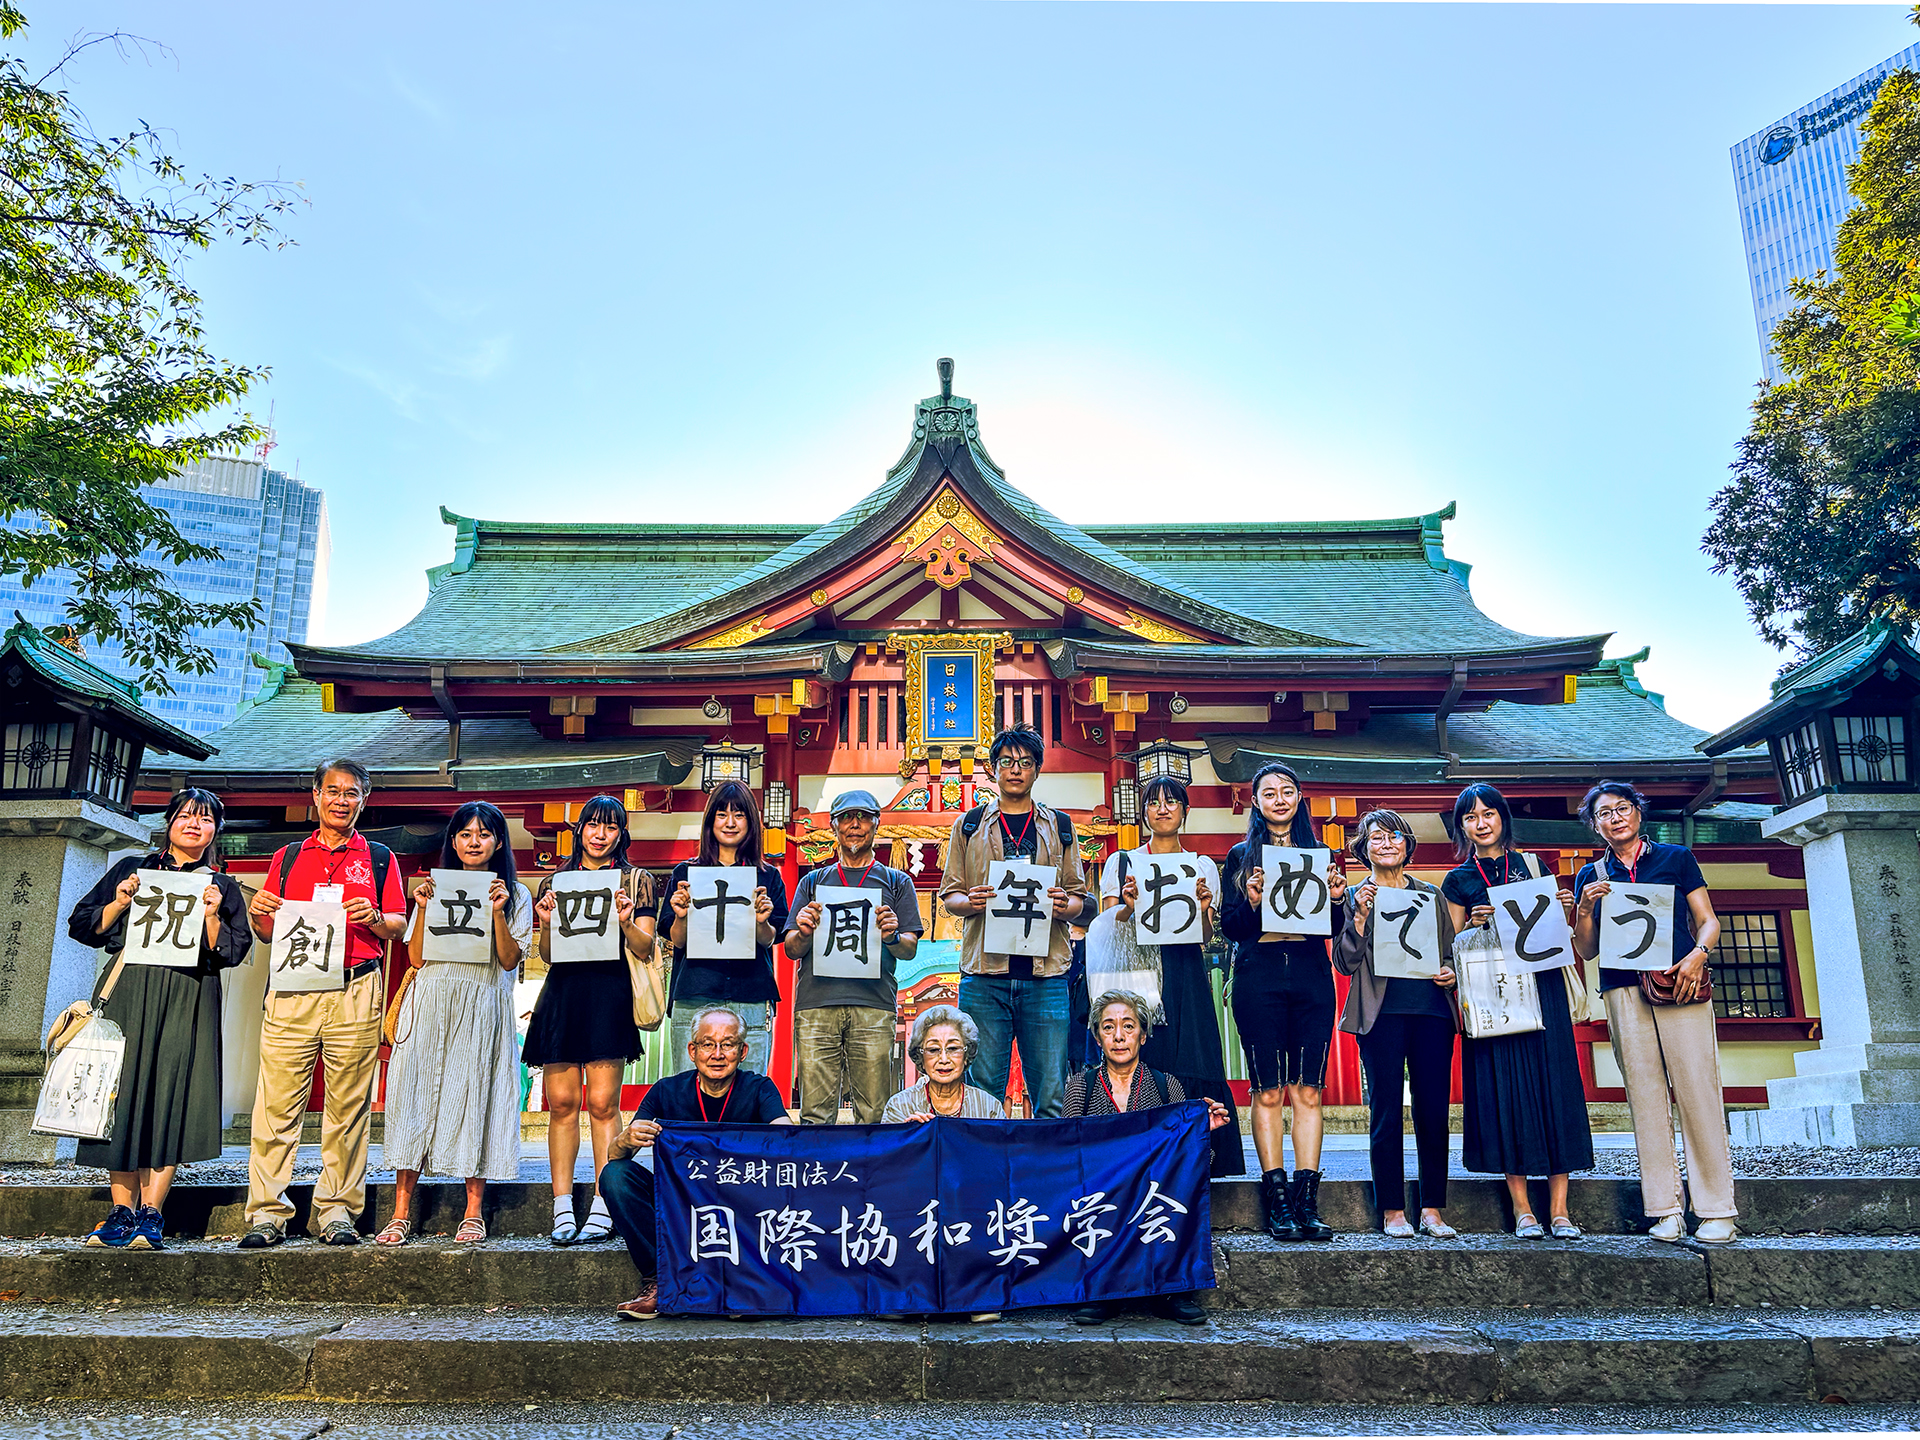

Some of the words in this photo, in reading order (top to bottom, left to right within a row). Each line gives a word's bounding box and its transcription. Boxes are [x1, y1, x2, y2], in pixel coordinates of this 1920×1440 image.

[1797, 69, 1887, 132] Prudential
[943, 662, 958, 730] 日枝神社
[12, 870, 33, 905] 奉献
[427, 888, 487, 938] 立
[554, 886, 613, 938] 四
[692, 879, 752, 945] 十
[990, 869, 1047, 939] 年
[1140, 863, 1198, 935] お
[1269, 852, 1328, 920] め
[1879, 864, 1901, 897] 奉献
[132, 883, 198, 950] 祝
[276, 914, 335, 973] 創
[823, 897, 873, 966] 周
[1380, 893, 1431, 960] で
[1502, 893, 1565, 963] と
[1610, 893, 1657, 960] う
[687, 1158, 860, 1190] 公益財団法人
[689, 1180, 1189, 1272] 国際協和奨学会
